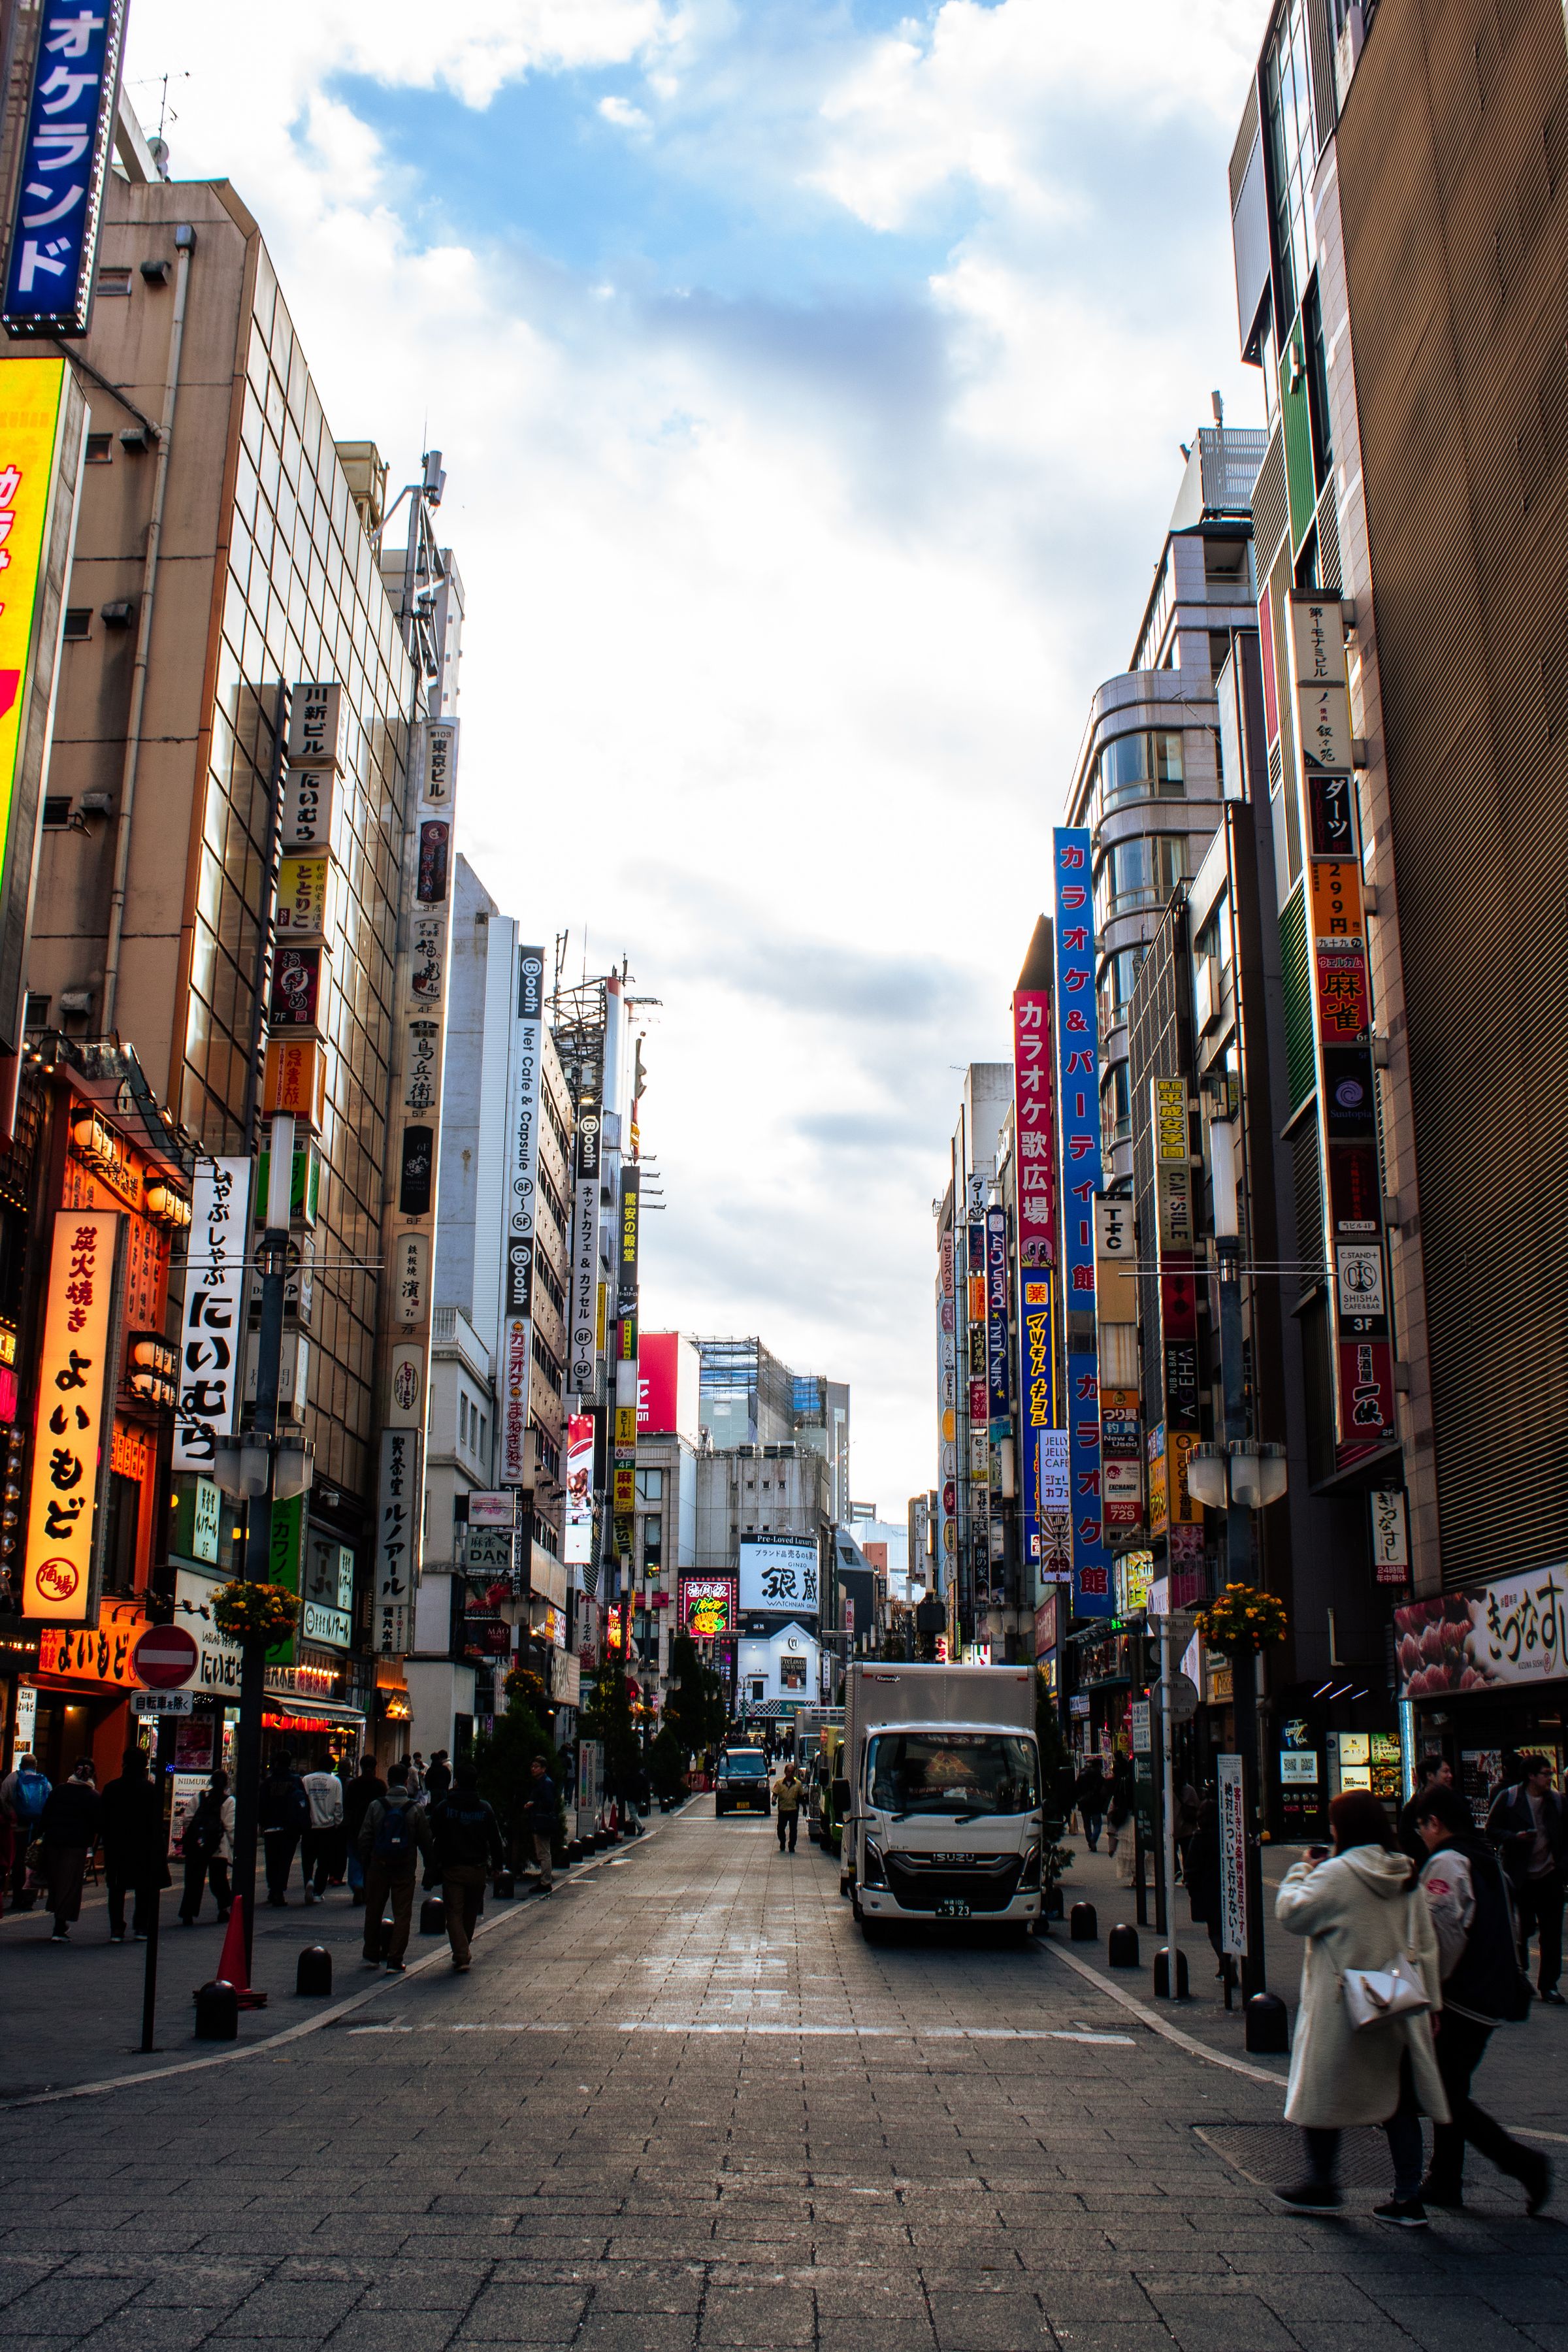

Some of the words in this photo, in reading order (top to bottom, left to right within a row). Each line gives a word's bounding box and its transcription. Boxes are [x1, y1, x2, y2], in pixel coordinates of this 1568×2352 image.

[19, 0, 104, 292] オケランド
[302, 688, 327, 753] 川新ビル
[1320, 708, 1328, 722] 焼肉
[1316, 725, 1335, 762] 叙々苑
[429, 740, 448, 797] 東京ビル
[1326, 779, 1348, 838] ダーツ
[1329, 864, 1348, 934] 299円
[1318, 938, 1348, 947] 九十九
[1318, 956, 1364, 968] ウェルカム
[427, 983, 438, 992] 4F
[521, 957, 542, 1012] Booth
[1320, 971, 1363, 1032] 麻雀
[274, 1013, 286, 1022] 7F
[523, 1027, 534, 1051] Net
[284, 1049, 302, 1105] 鳥貴族
[521, 1056, 534, 1091] Cafe
[1158, 1081, 1183, 1091] 新宿
[521, 1096, 532, 1105] &
[517, 1114, 532, 1171] Capsule
[580, 1117, 600, 1168] Booth
[1159, 1092, 1185, 1159] 平成女学園
[416, 1143, 429, 1152] 6F
[517, 1182, 530, 1192] 8F
[516, 1217, 529, 1226] 5F
[581, 1186, 593, 1252] ネットカフェ
[1169, 1173, 1188, 1240] CAPSULE
[203, 1168, 233, 1286] しゃぶしゃぶ
[623, 1192, 637, 1262] 驚安の殿堂
[1104, 1208, 1122, 1250] TFC
[65, 1226, 97, 1333] 炭火焼き
[510, 1245, 532, 1305] Booth
[580, 1258, 591, 1268] &
[578, 1275, 591, 1320] カプセル
[1027, 1285, 1046, 1303] 薬
[1343, 1294, 1380, 1303] SHISHA
[578, 1332, 589, 1341] 8F
[1353, 1318, 1373, 1331] 3F
[508, 1331, 525, 1388] カラオケ
[577, 1365, 588, 1373] 5F
[990, 1321, 1006, 1387] SHINJUKU
[1027, 1312, 1048, 1426] マツモトキヨシ
[1358, 1345, 1374, 1383] 居酒屋
[182, 1292, 233, 1461] にいむら
[1178, 1348, 1196, 1418] AGEHA
[1102, 1409, 1138, 1421] つり具
[1107, 1422, 1136, 1434] 釣具
[44, 1348, 93, 1539] よいもど
[507, 1400, 524, 1479] まねきねこ
[617, 1471, 632, 1499] 麻雀
[1077, 1374, 1109, 1595] カラオケ館
[1110, 1511, 1135, 1520] 729
[382, 1504, 408, 1595] ルノアール
[470, 1535, 495, 1548] 麻雀
[470, 1549, 508, 1563] DAN
[757, 1535, 794, 1544] Pre-Loved
[795, 1537, 811, 1548] Luxury
[40, 1563, 75, 1595] 酒場
[1377, 1566, 1405, 1575] 24時間
[487, 1626, 509, 1635] MAO
[58, 1629, 129, 1680] よいもど
[135, 1697, 189, 1712] 自転車を除く
[177, 1777, 210, 1786] NIIMURA
[932, 1853, 975, 1862] ISUZU
[1233, 1786, 1245, 1934] 客引きは条例違反です
[958, 1905, 970, 1916] 23
